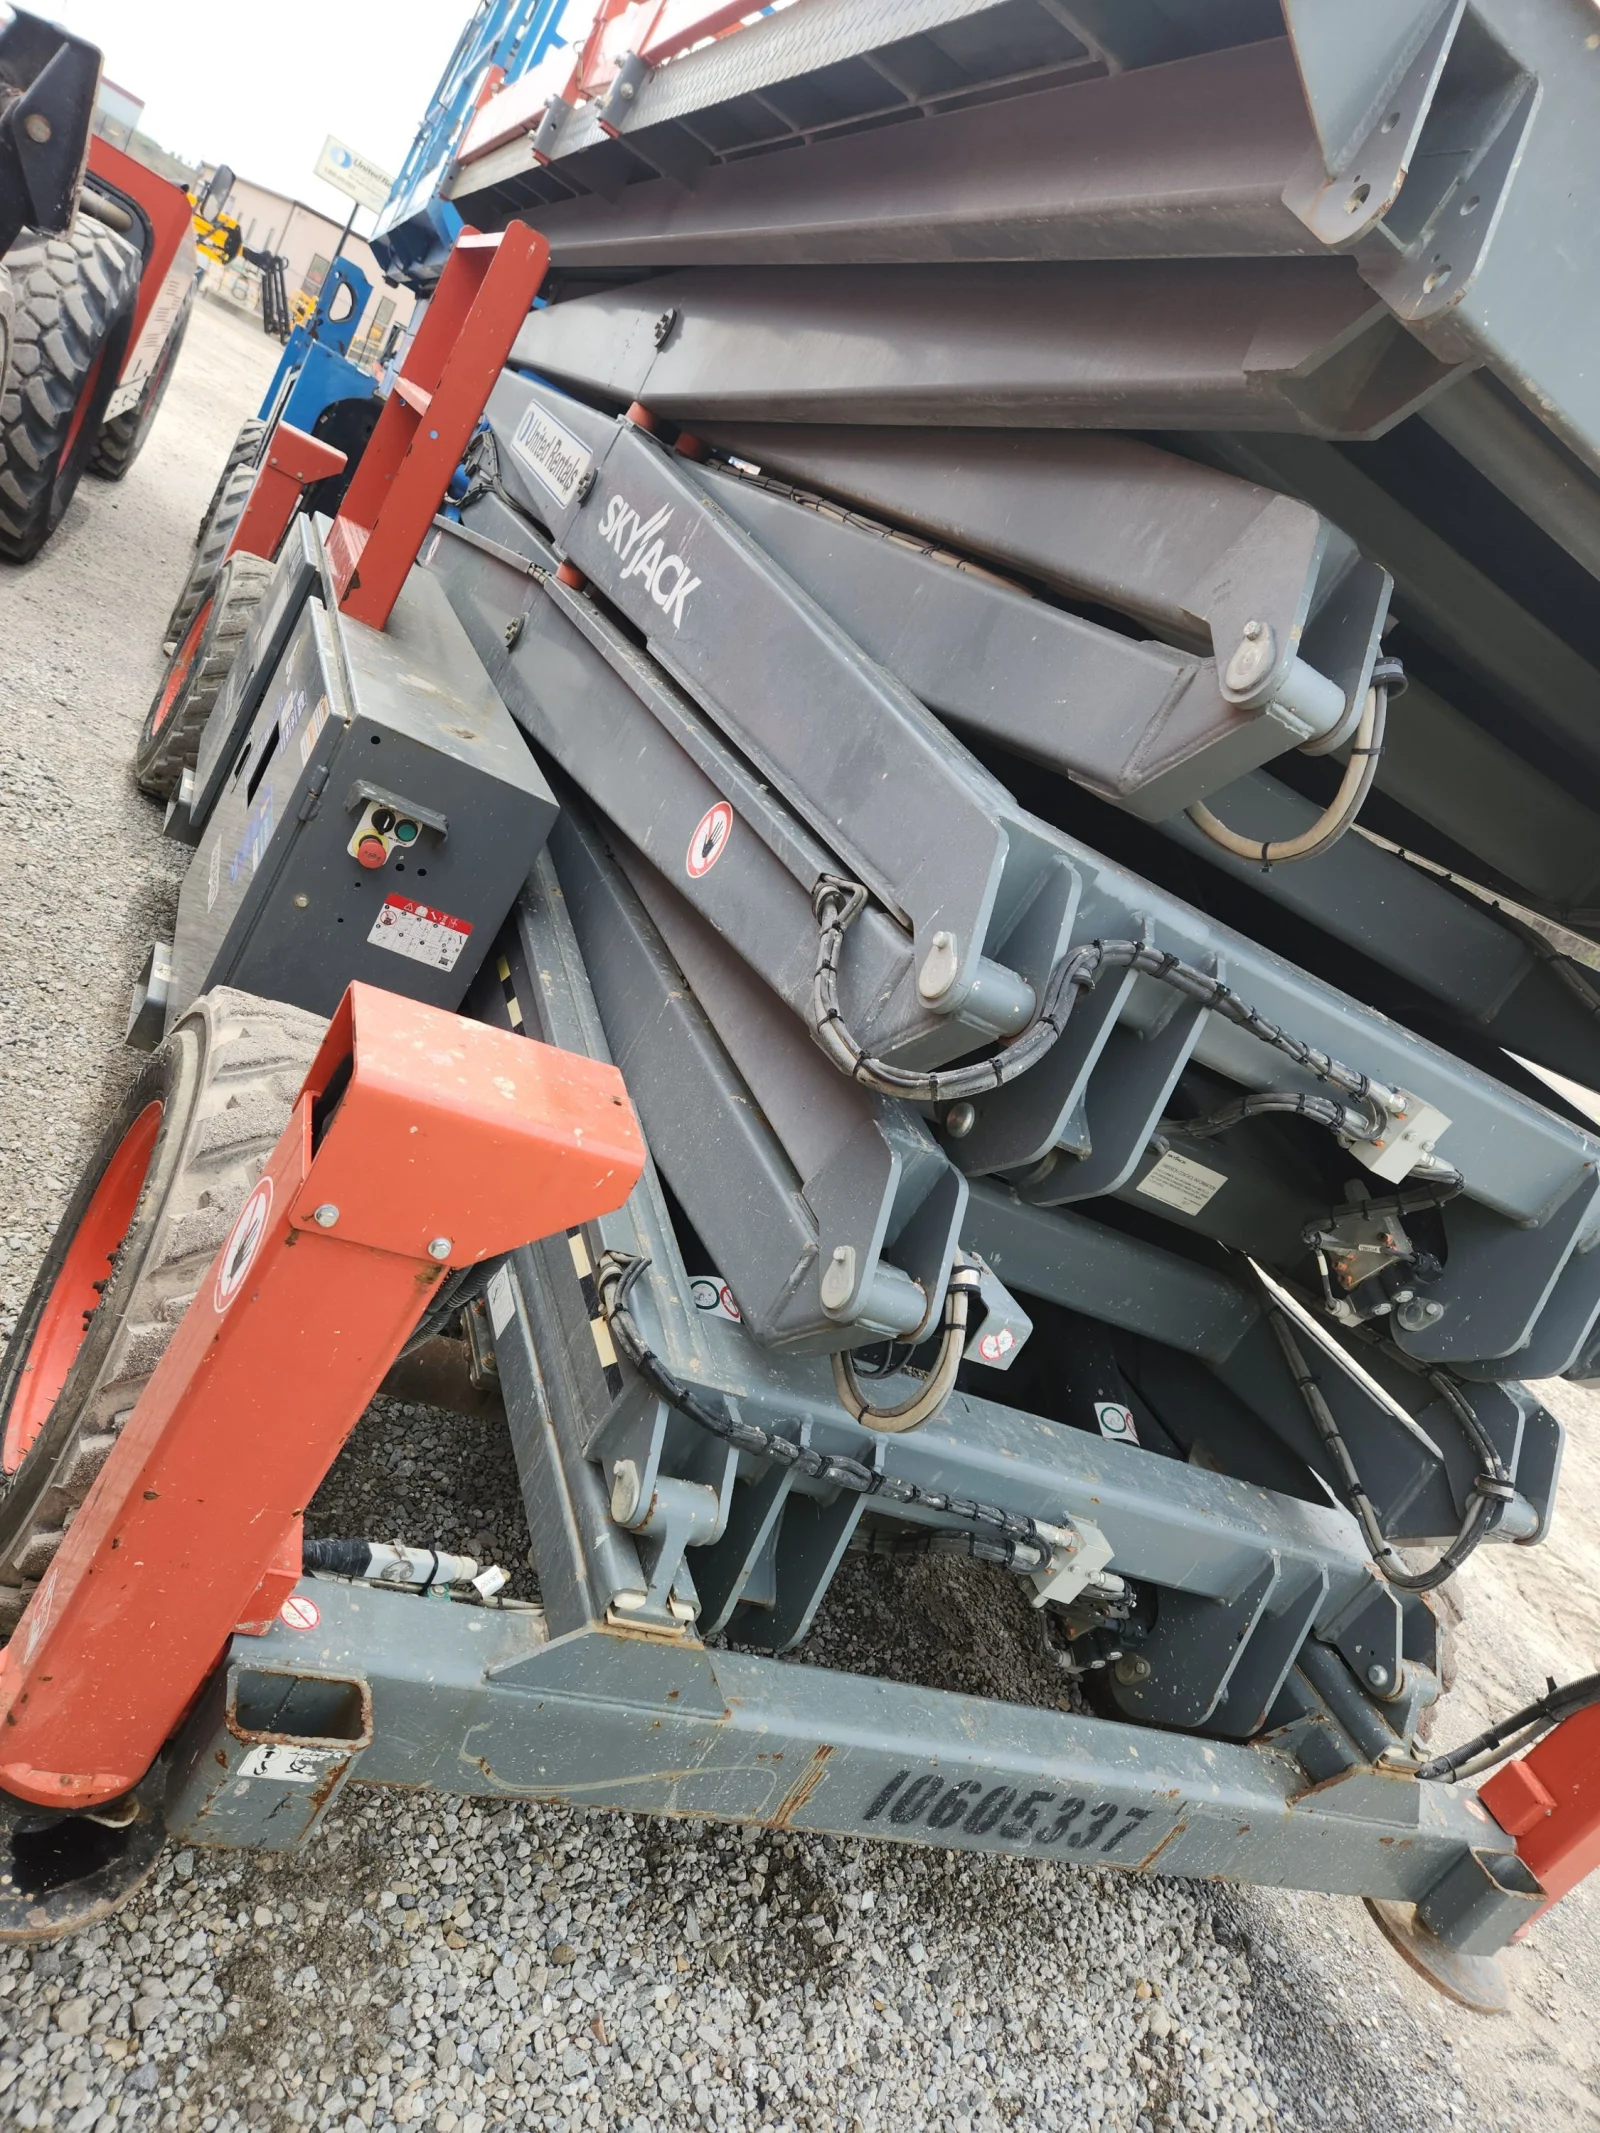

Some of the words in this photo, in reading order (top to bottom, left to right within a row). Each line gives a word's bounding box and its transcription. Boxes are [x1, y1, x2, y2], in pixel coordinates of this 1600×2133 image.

[353, 158, 383, 181] United
[525, 419, 557, 462] United
[544, 439, 580, 492] Rentals
[598, 494, 702, 629] SKYJACK
[863, 1770, 1155, 1852] 10605337
